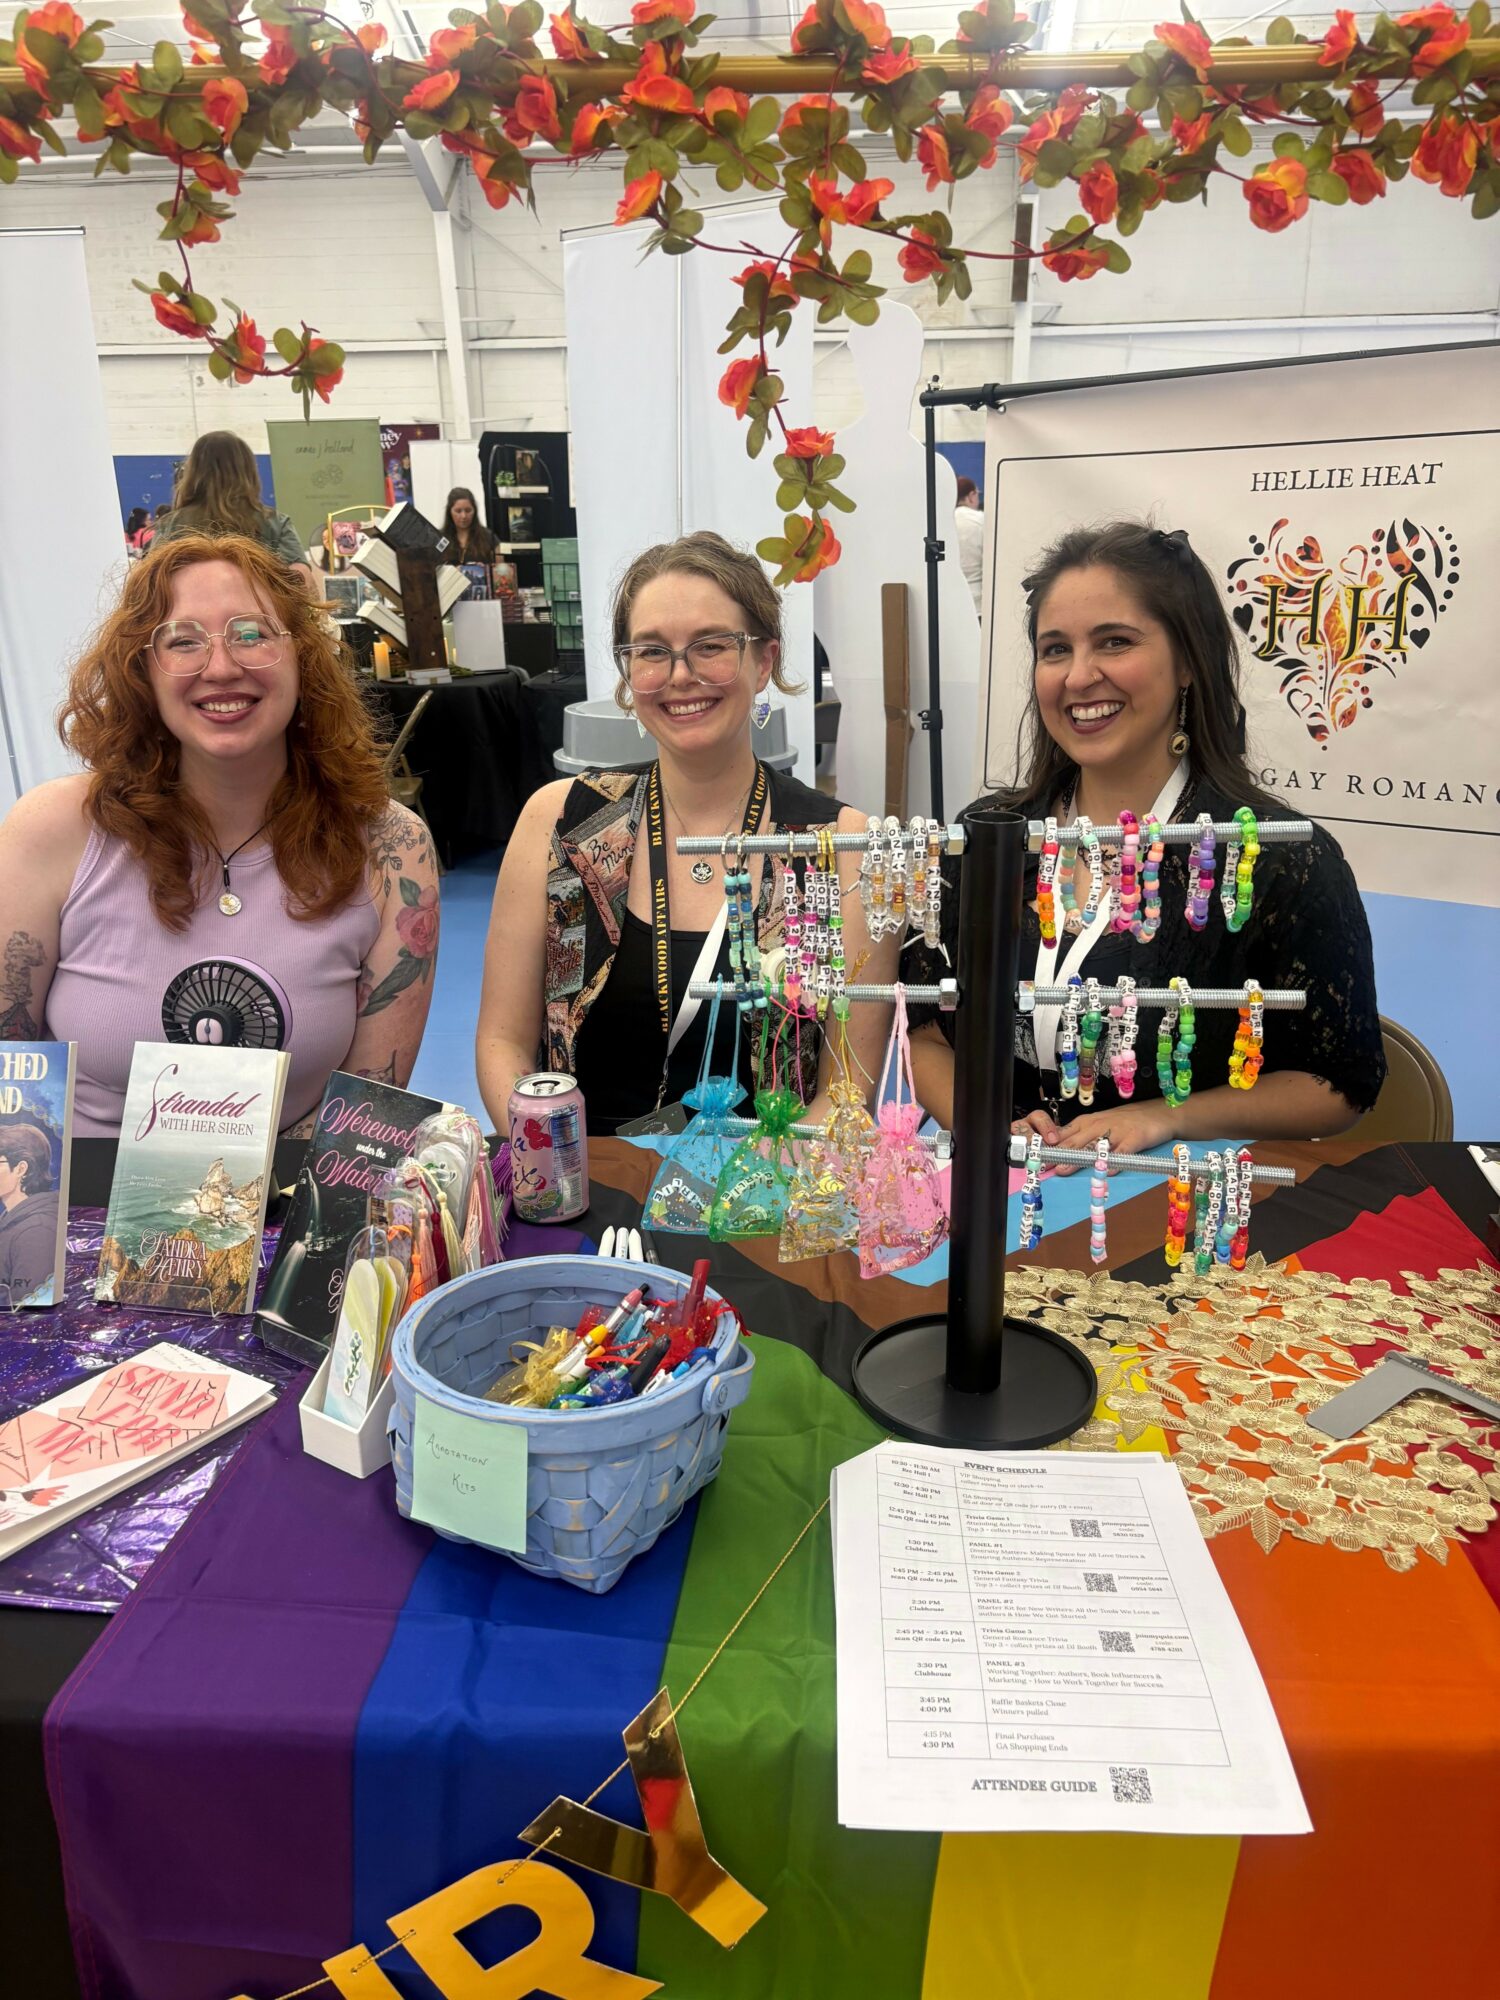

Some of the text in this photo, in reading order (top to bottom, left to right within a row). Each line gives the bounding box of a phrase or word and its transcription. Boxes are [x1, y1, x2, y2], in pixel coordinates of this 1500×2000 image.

[1250, 462, 1444, 492] HELLIE HEAT
[1260, 768, 1500, 805] GAY ROMAN
[588, 838, 611, 865] Be
[1086, 843, 1104, 911] ROTTING
[804, 874, 817, 913] MORE
[816, 874, 827, 915] MORE
[830, 877, 840, 917] MORE
[655, 878, 669, 1032] BLACKWOOD AFFAIRS
[1064, 986, 1080, 1051] ATTRACT
[1250, 1004, 1263, 1037] BURN
[1109, 1016, 1120, 1057] FLUFF
[135, 1063, 262, 1141] Stranded
[160, 1117, 255, 1137] WITH HER SIREN
[356, 1143, 388, 1160] under the
[316, 1150, 385, 1193] Water
[1240, 1161, 1252, 1226] WARNING
[1202, 1181, 1222, 1255] ROOMMATES
[140, 1227, 207, 1261] SANDRA
[144, 1253, 208, 1283] HENRY
[964, 1461, 995, 1471] EVENT
[972, 1474, 1001, 1482] Shopping
[973, 1494, 1003, 1502] Shopping
[905, 1545, 938, 1553] Clubhouse
[987, 1668, 1019, 1676] Working
[1021, 1669, 1057, 1677] Together:
[988, 1677, 1027, 1685] Marketing
[1085, 1680, 1119, 1688] Together
[920, 1705, 937, 1713] 4:00
[992, 1707, 1049, 1717] Winners pulled
[922, 1741, 955, 1749] 4:30 PM
[923, 1730, 952, 1738] 4:15 PM
[995, 1732, 1055, 1741] Final Purchases
[1010, 1743, 1047, 1752] Shopping
[971, 1779, 1098, 1792] ATTENDEE GUIDE
